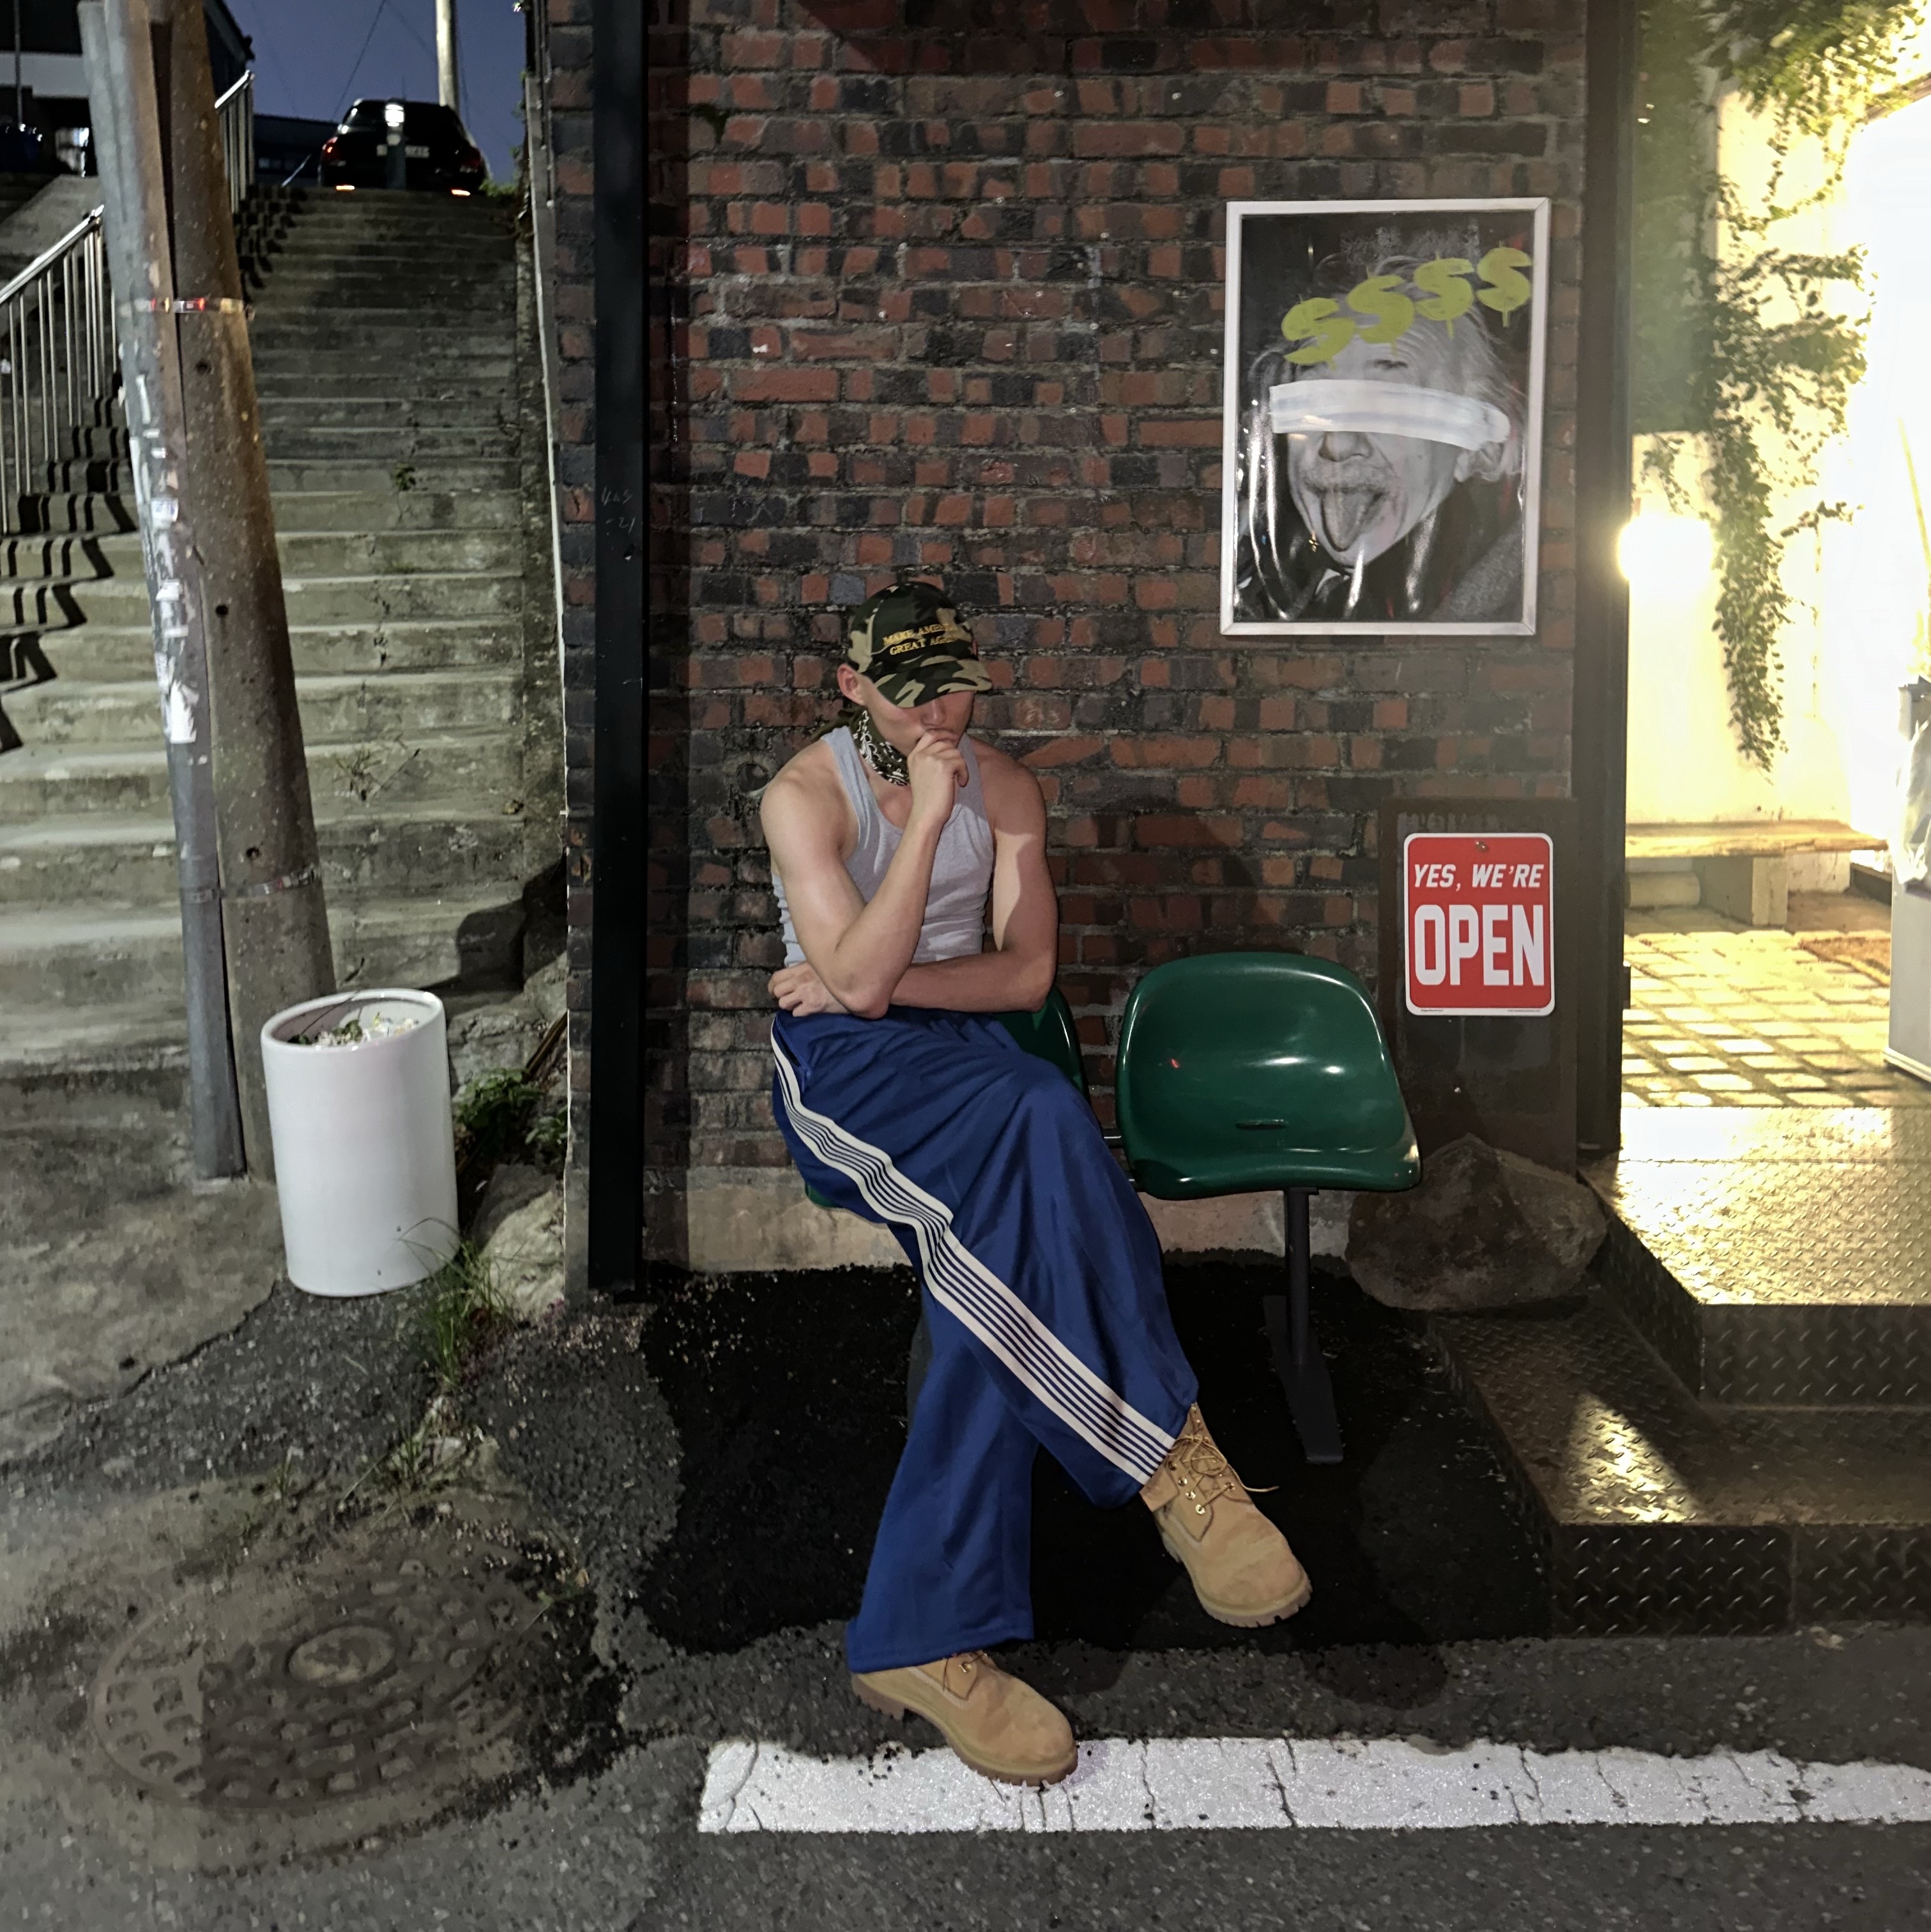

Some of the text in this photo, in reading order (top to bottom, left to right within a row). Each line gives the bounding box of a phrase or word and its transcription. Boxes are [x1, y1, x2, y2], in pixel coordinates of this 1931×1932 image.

[882, 624, 958, 645] MAKE AMER
[890, 638, 926, 655] GREAT
[1414, 864, 1545, 891] YES, WE'RE
[1414, 904, 1545, 986] OPEN
